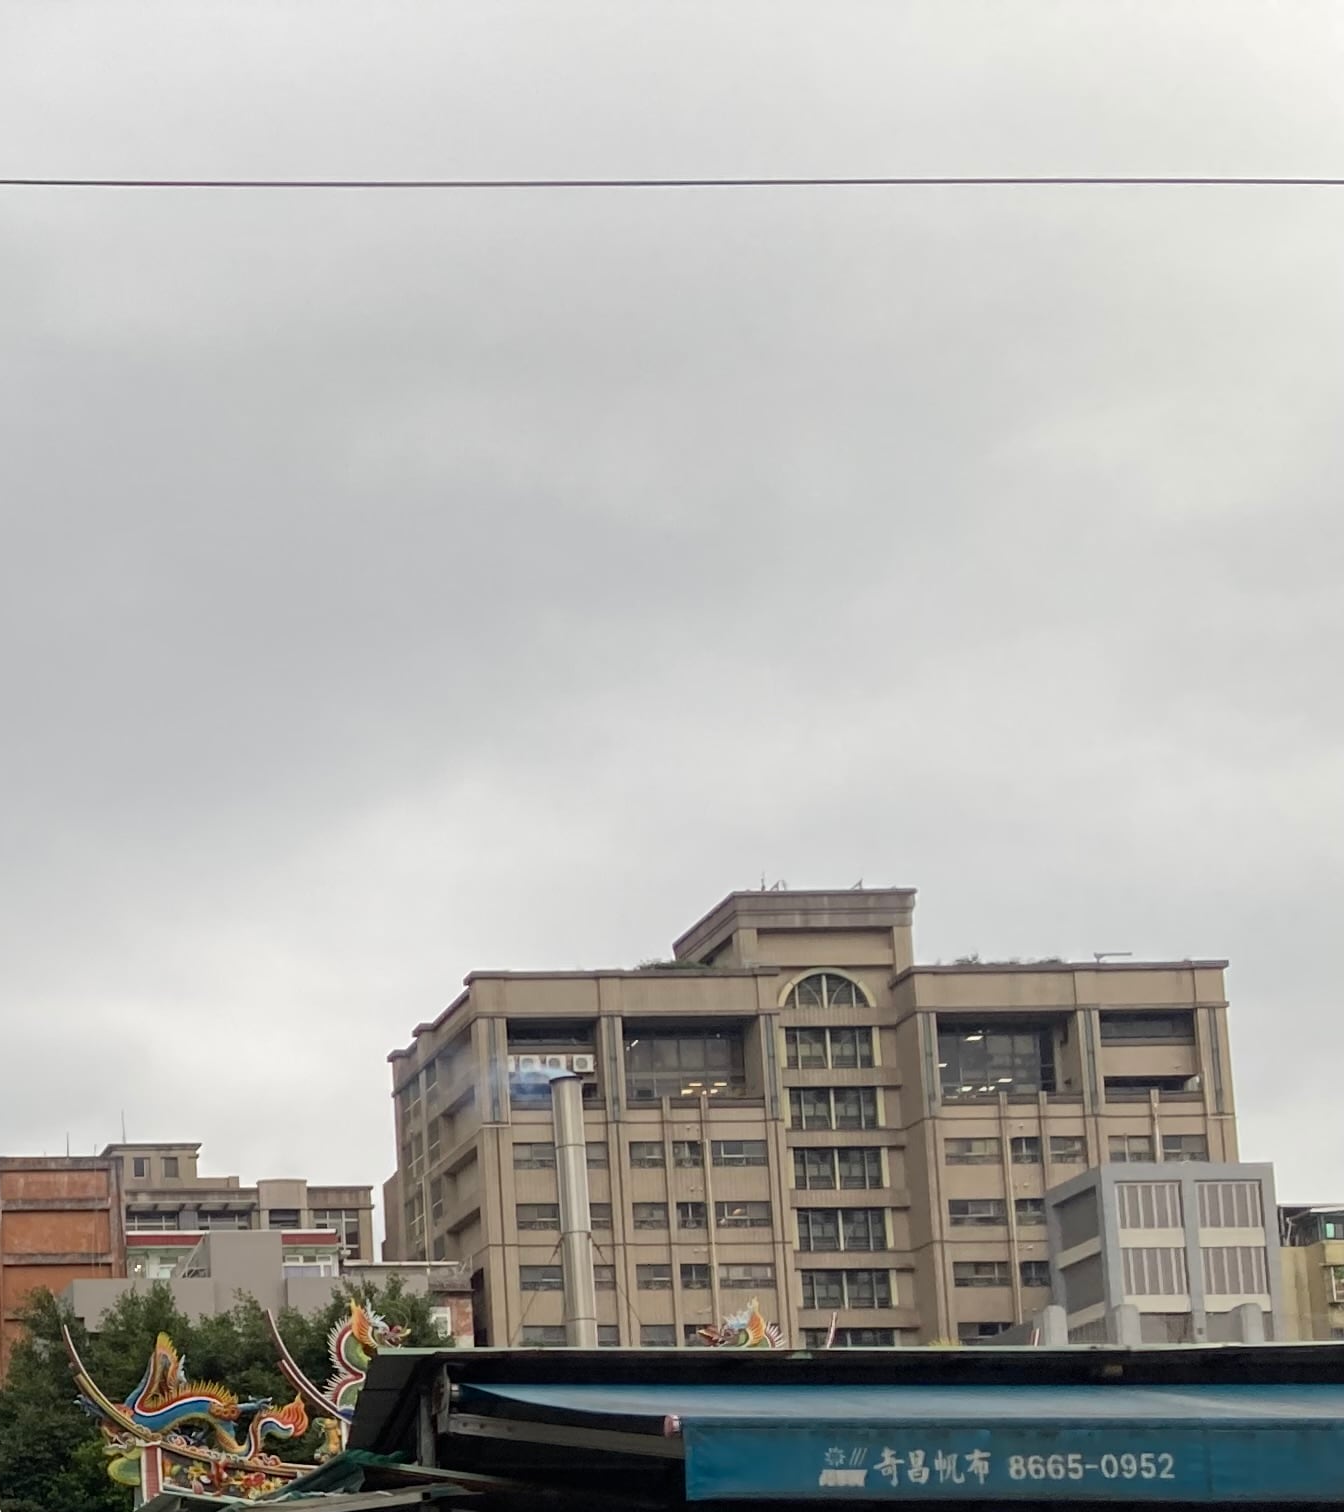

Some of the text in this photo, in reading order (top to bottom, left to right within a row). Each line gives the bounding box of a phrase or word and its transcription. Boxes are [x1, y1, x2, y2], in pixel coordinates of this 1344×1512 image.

[873, 1447, 1177, 1488] 奇昌帆布 8665-0952
